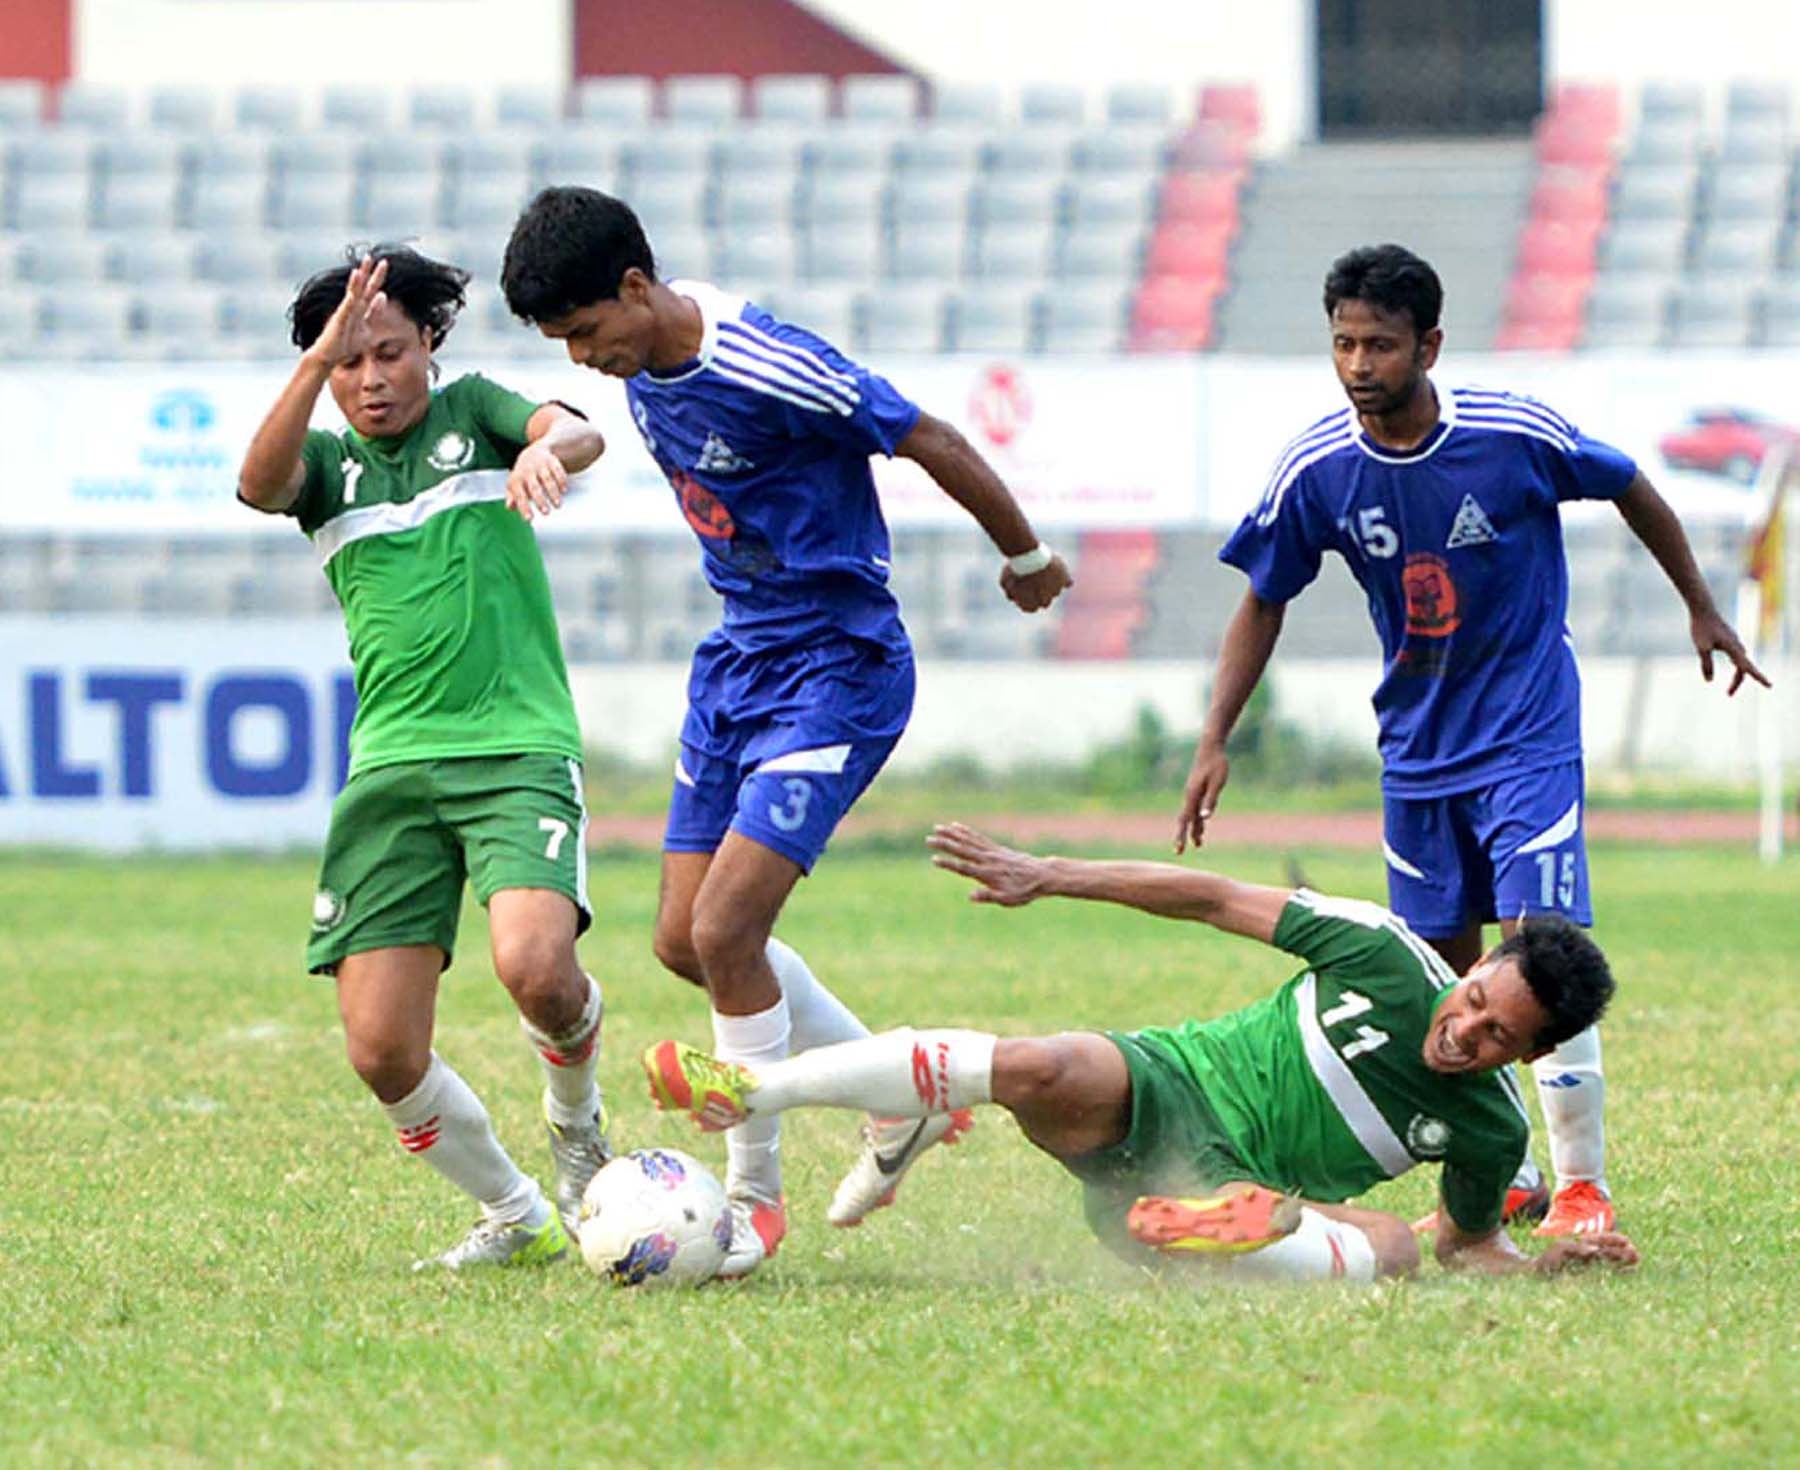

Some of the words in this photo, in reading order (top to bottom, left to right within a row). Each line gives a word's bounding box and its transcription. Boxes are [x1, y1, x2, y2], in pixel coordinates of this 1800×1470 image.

[0, 672, 356, 798] LTO
[769, 778, 812, 831] 3
[538, 817, 568, 860] 7
[1535, 852, 1576, 908] 15
[1321, 991, 1390, 1060] 11
